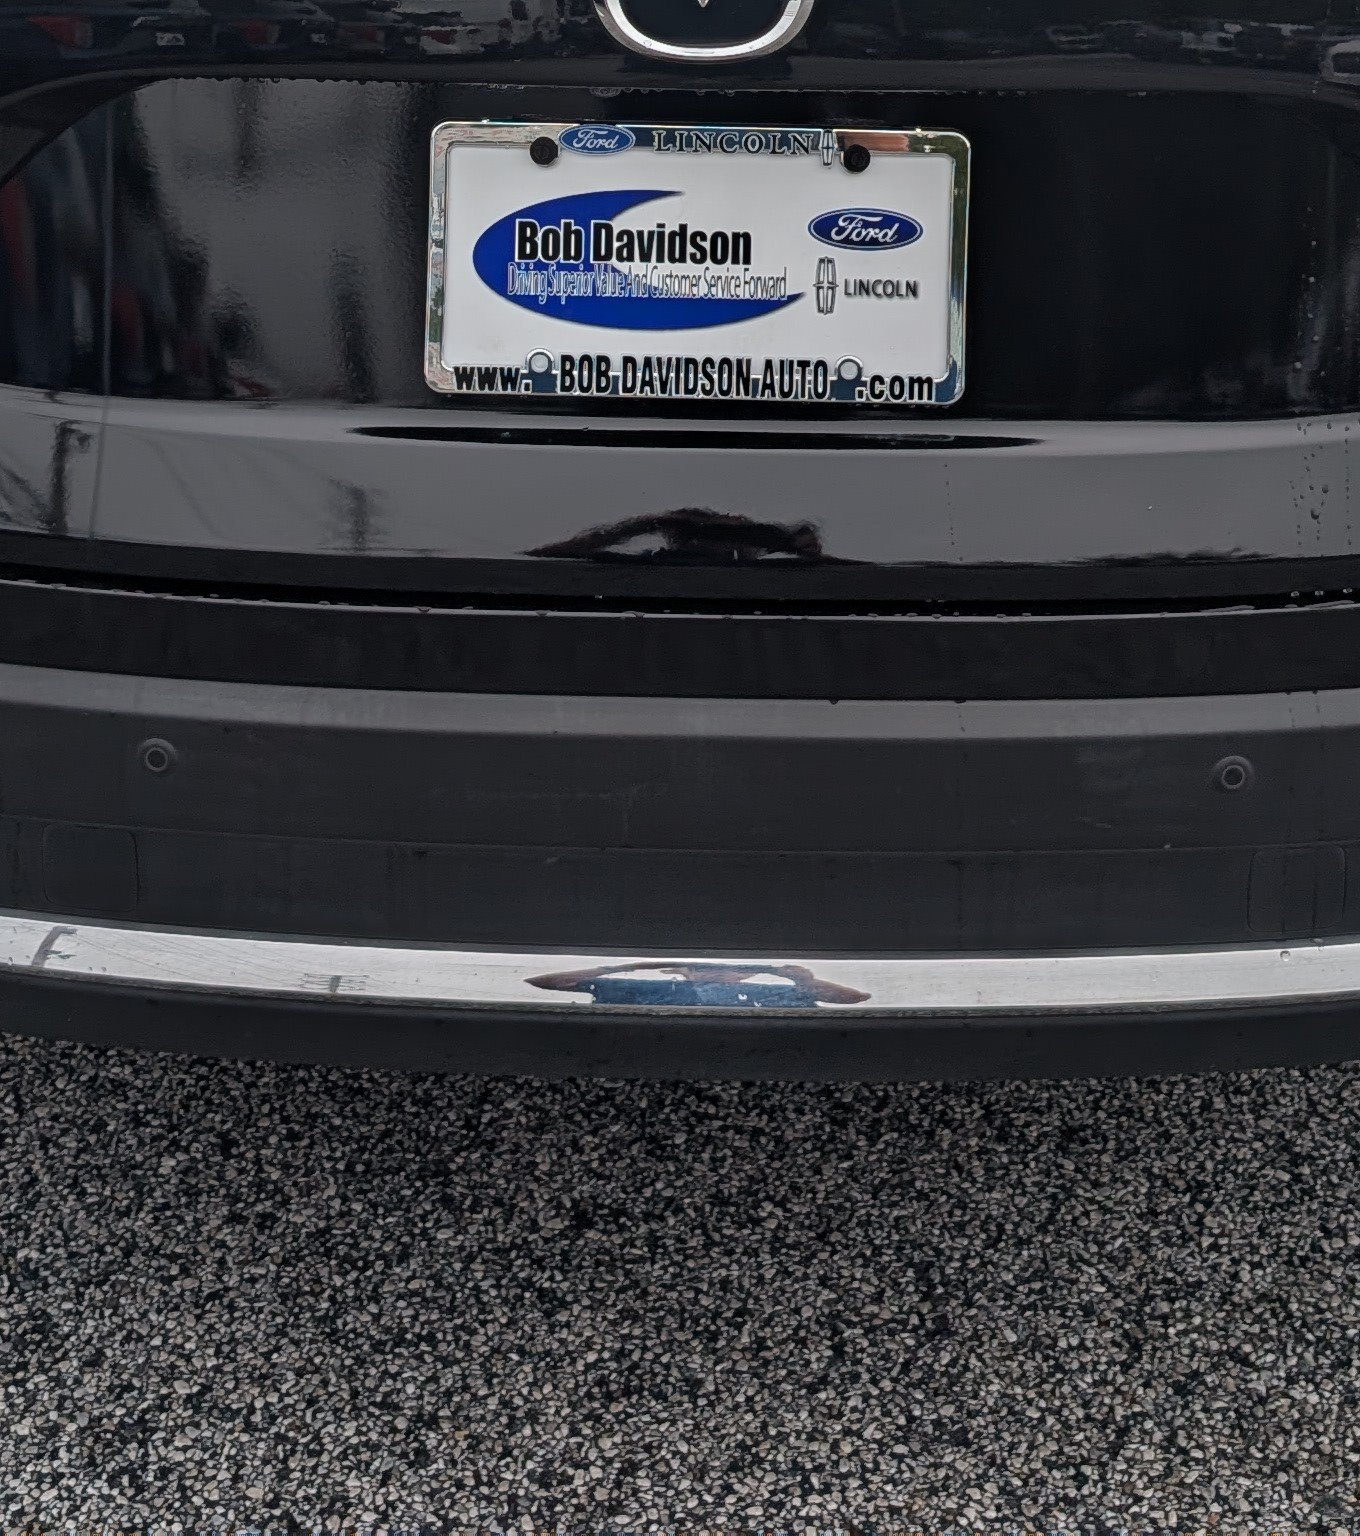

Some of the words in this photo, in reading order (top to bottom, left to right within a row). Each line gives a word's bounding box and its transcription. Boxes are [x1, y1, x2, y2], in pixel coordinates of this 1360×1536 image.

[573, 129, 619, 150] Ford
[652, 129, 813, 155] LINCOLN
[516, 219, 585, 263] Bob
[590, 219, 752, 265] Davidson
[830, 214, 900, 243] Ford
[507, 262, 548, 304] Driving
[548, 262, 594, 304] Superior
[592, 263, 626, 297] Value
[624, 264, 649, 298] And
[650, 265, 702, 298] Customer
[703, 266, 741, 299] Service
[743, 266, 787, 300] Forward
[843, 278, 918, 298] LINCOLN
[452, 365, 532, 394] www.
[559, 353, 611, 394] BOB
[621, 355, 752, 397] DAVIDSON
[759, 358, 829, 400] AUTO
[855, 374, 935, 402] .com
